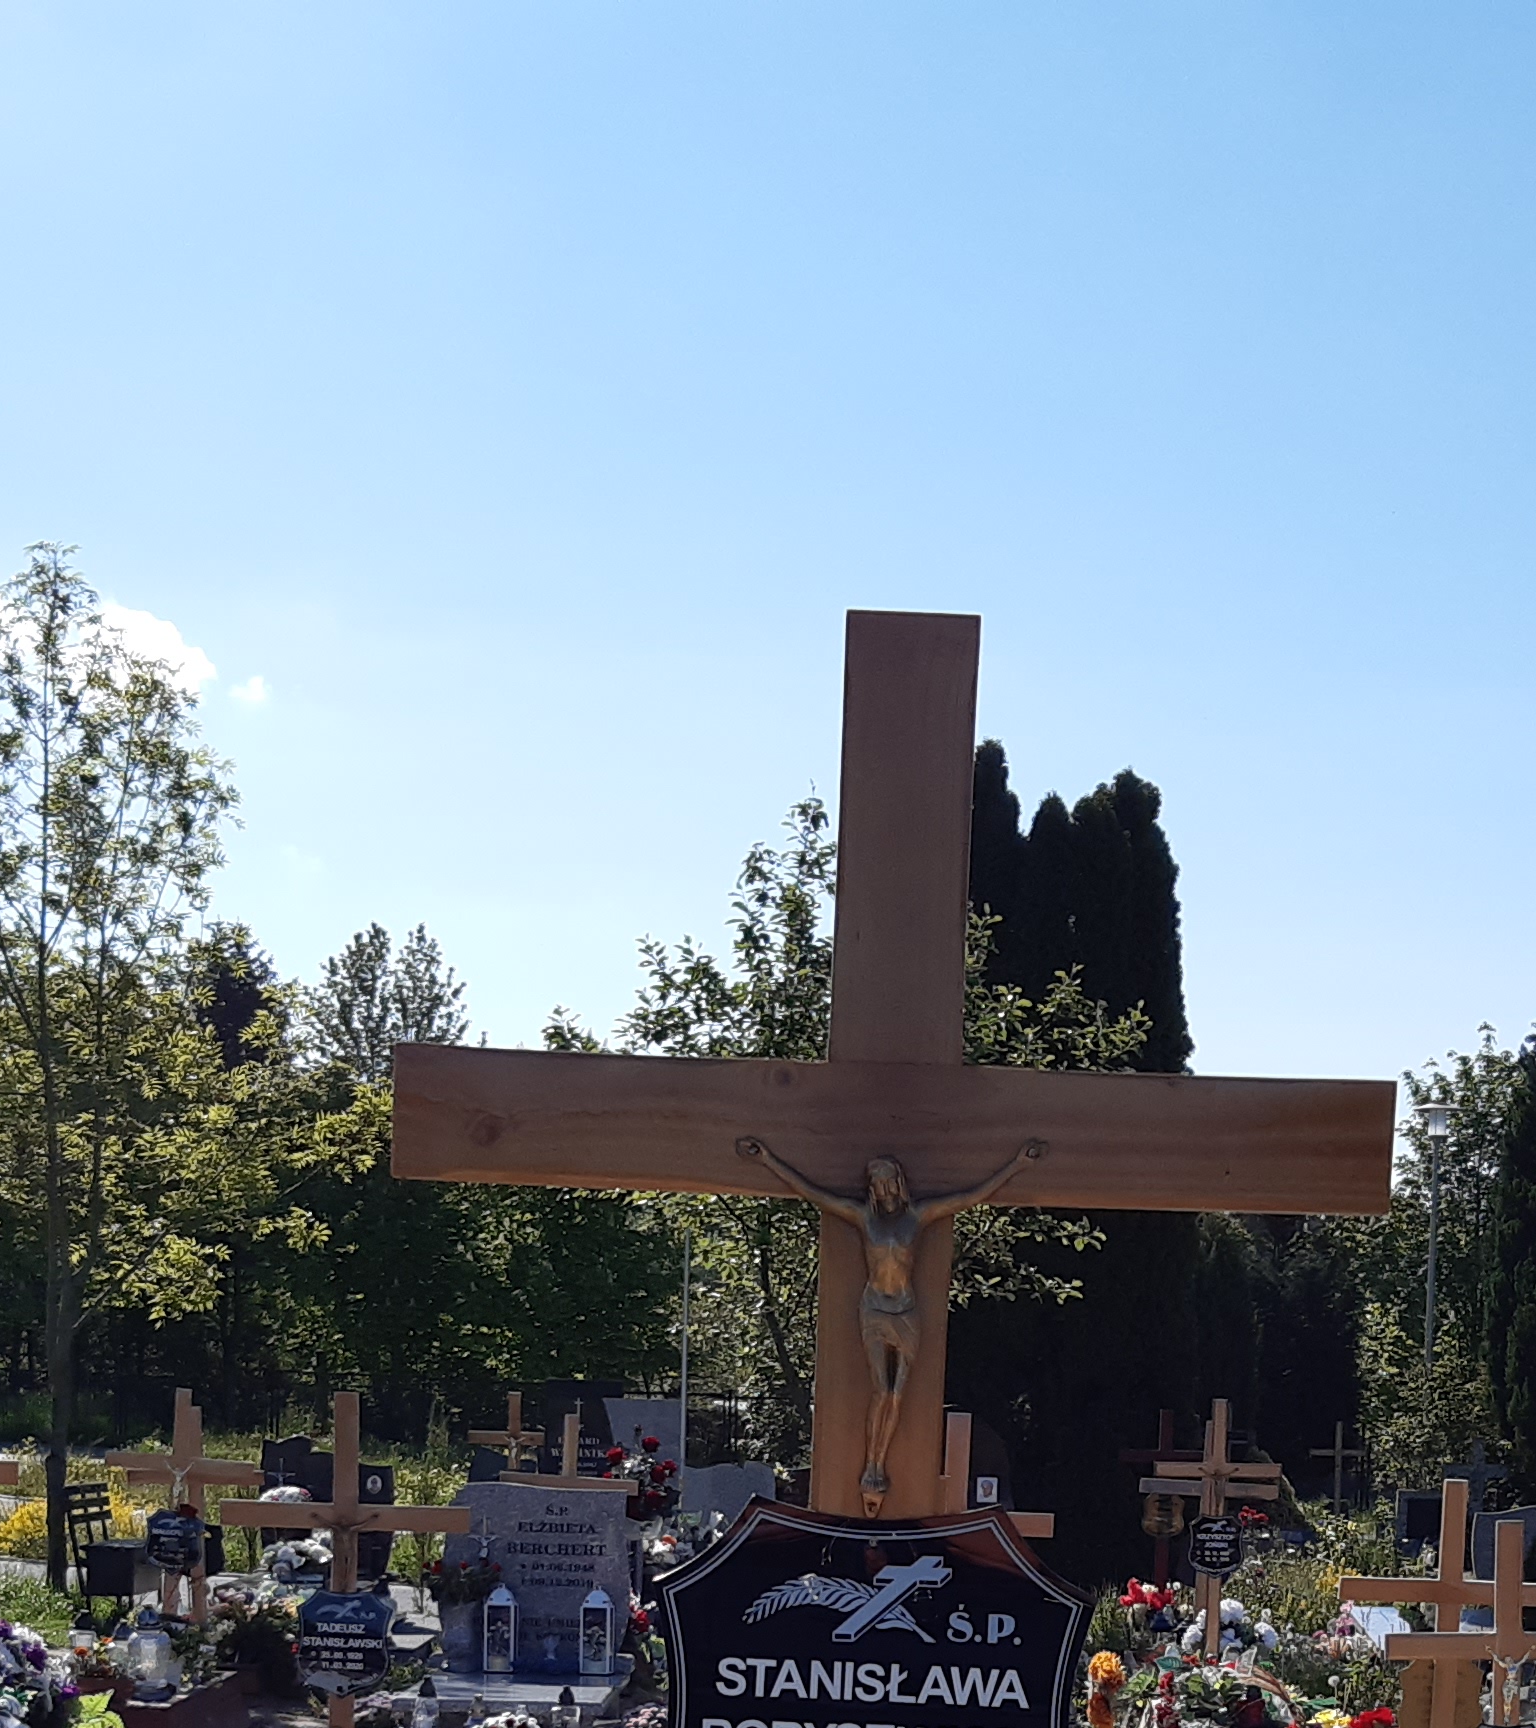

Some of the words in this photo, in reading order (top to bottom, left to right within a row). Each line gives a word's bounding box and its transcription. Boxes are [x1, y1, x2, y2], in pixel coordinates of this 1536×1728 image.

[517, 1521, 598, 1534] ELŻBIETA
[507, 1542, 607, 1556] BERCHERT
[316, 1622, 366, 1634] TADEUSZ
[303, 1636, 383, 1648] STANISŁAWSKI
[716, 1657, 1029, 1709] STANISŁAWA
